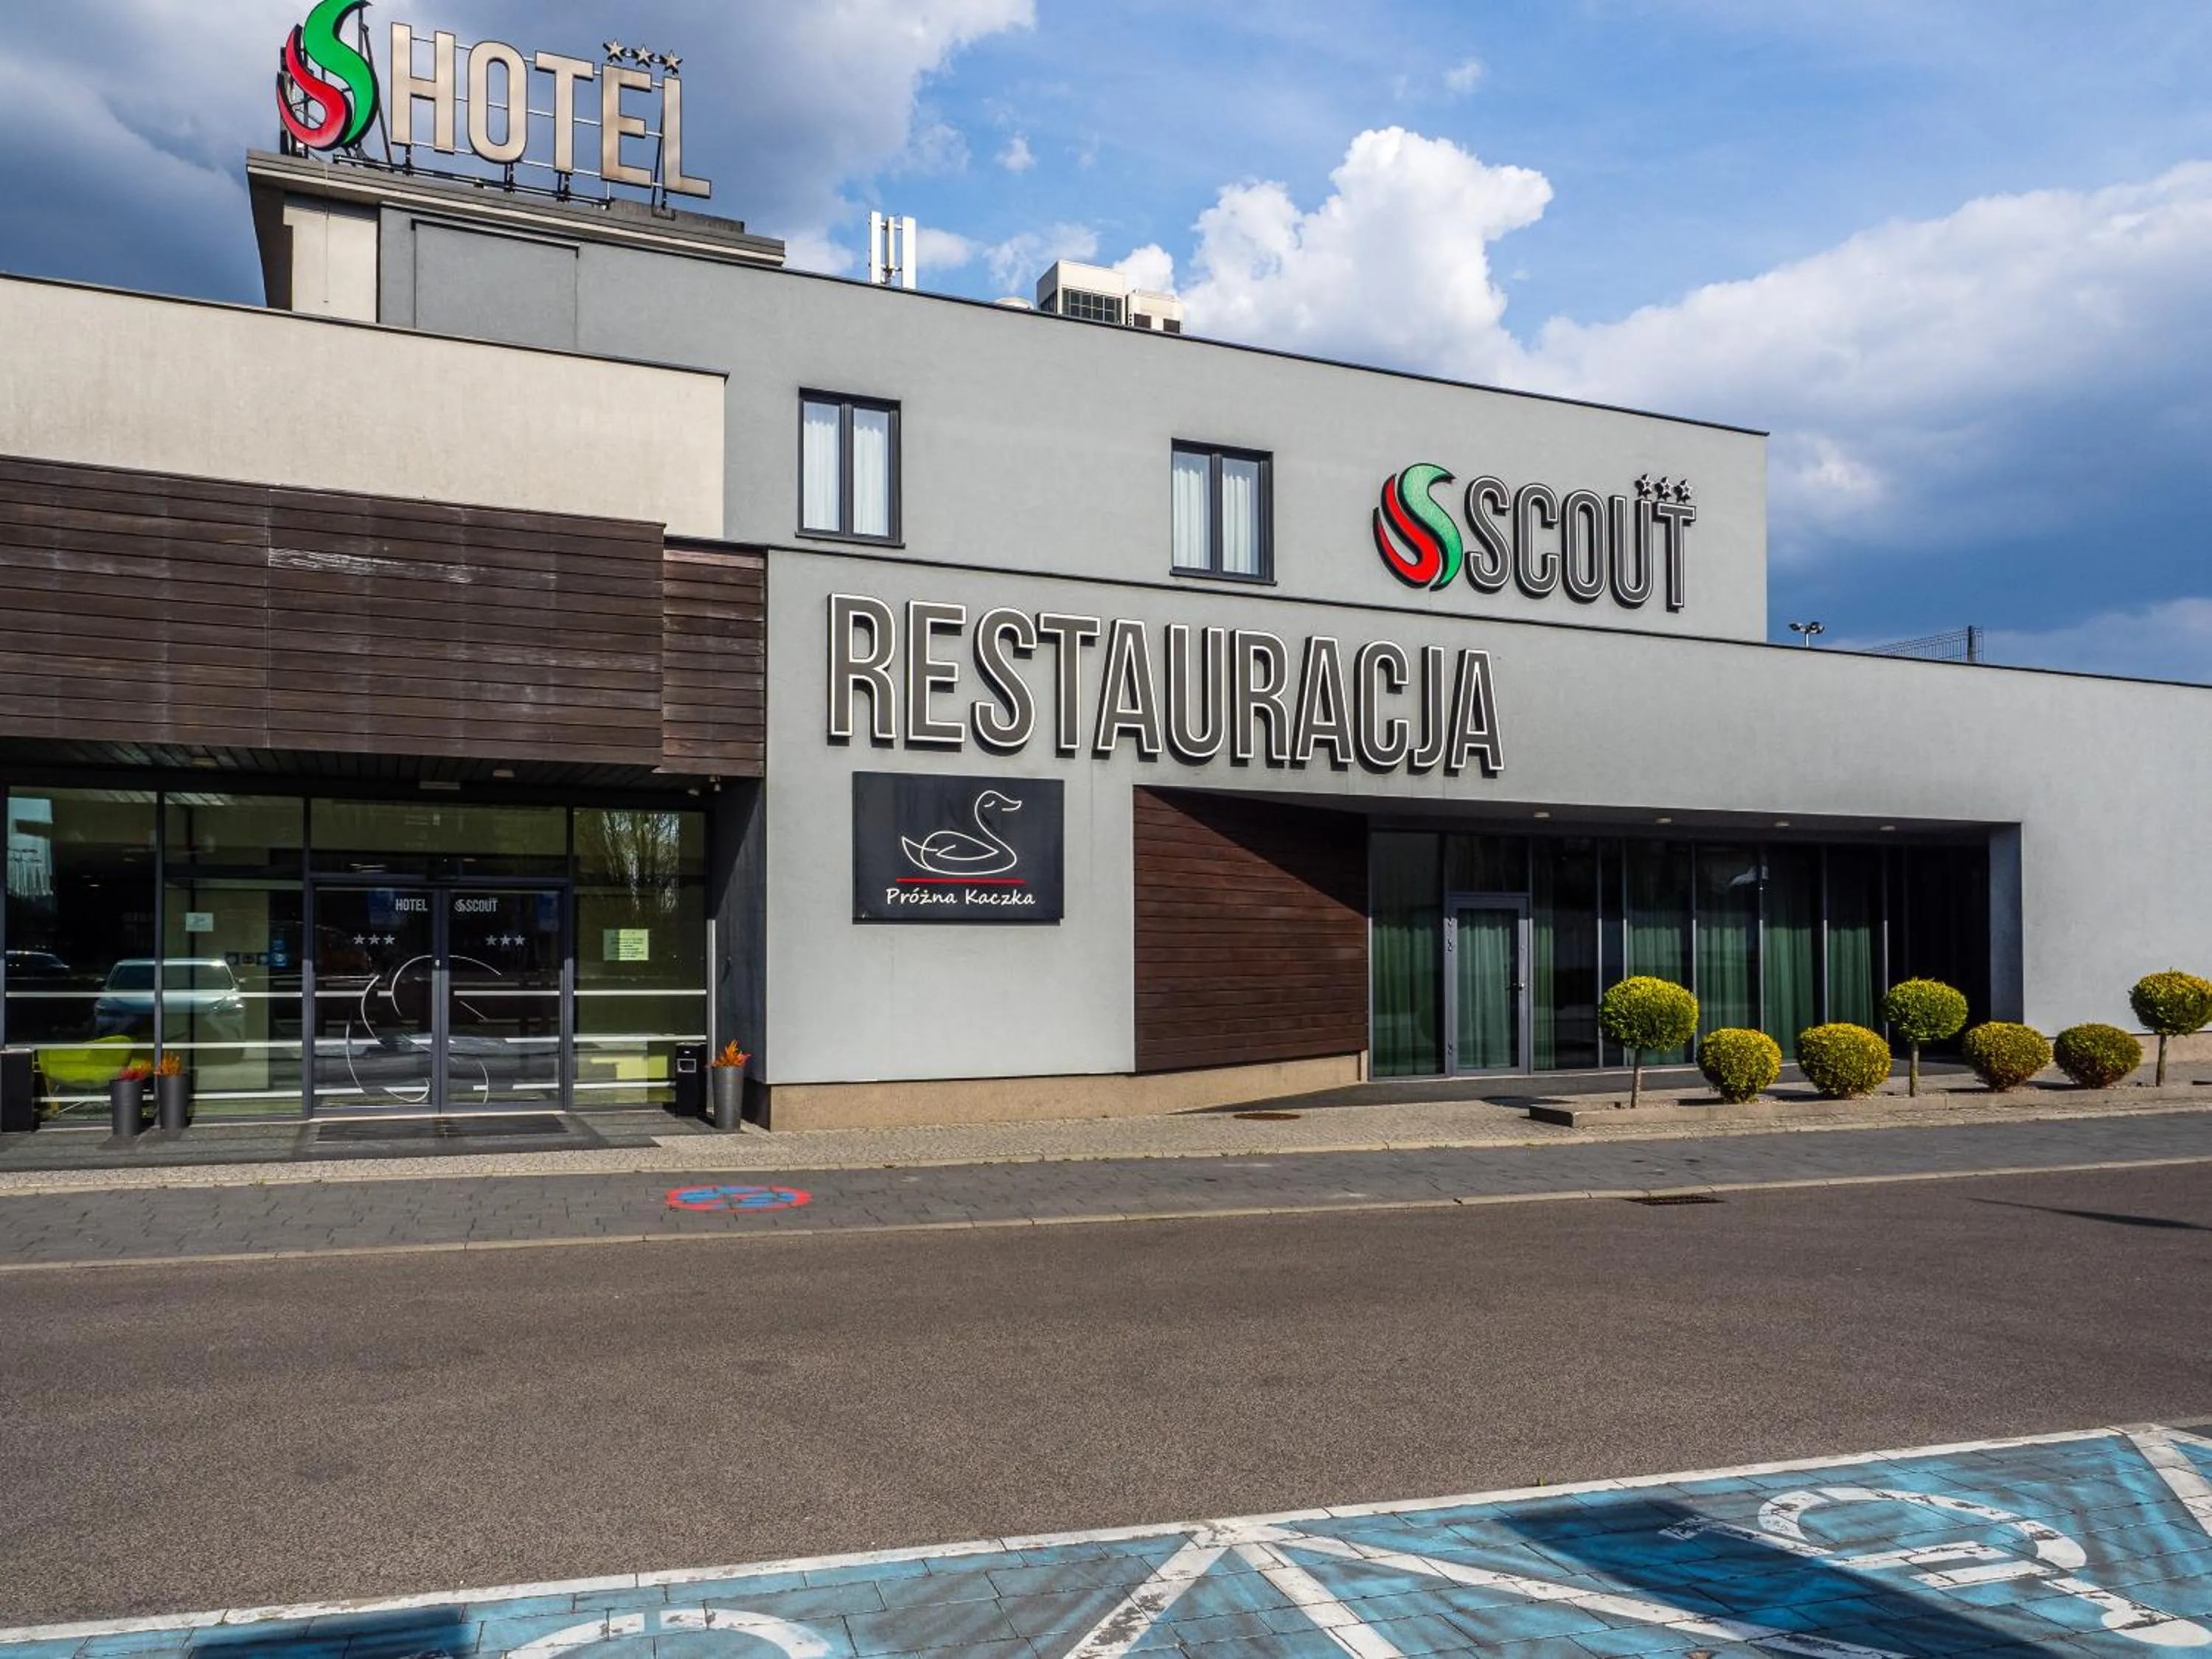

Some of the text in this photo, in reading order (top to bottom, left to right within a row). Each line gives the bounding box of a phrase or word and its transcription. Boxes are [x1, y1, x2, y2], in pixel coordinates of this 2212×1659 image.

[390, 21, 712, 199] HOTEL
[1464, 475, 1697, 613] SCOUT
[827, 592, 1504, 773] RESTAURACJA
[395, 898, 428, 911] HOTEL
[886, 887, 1035, 905] Próżna Kaczka
